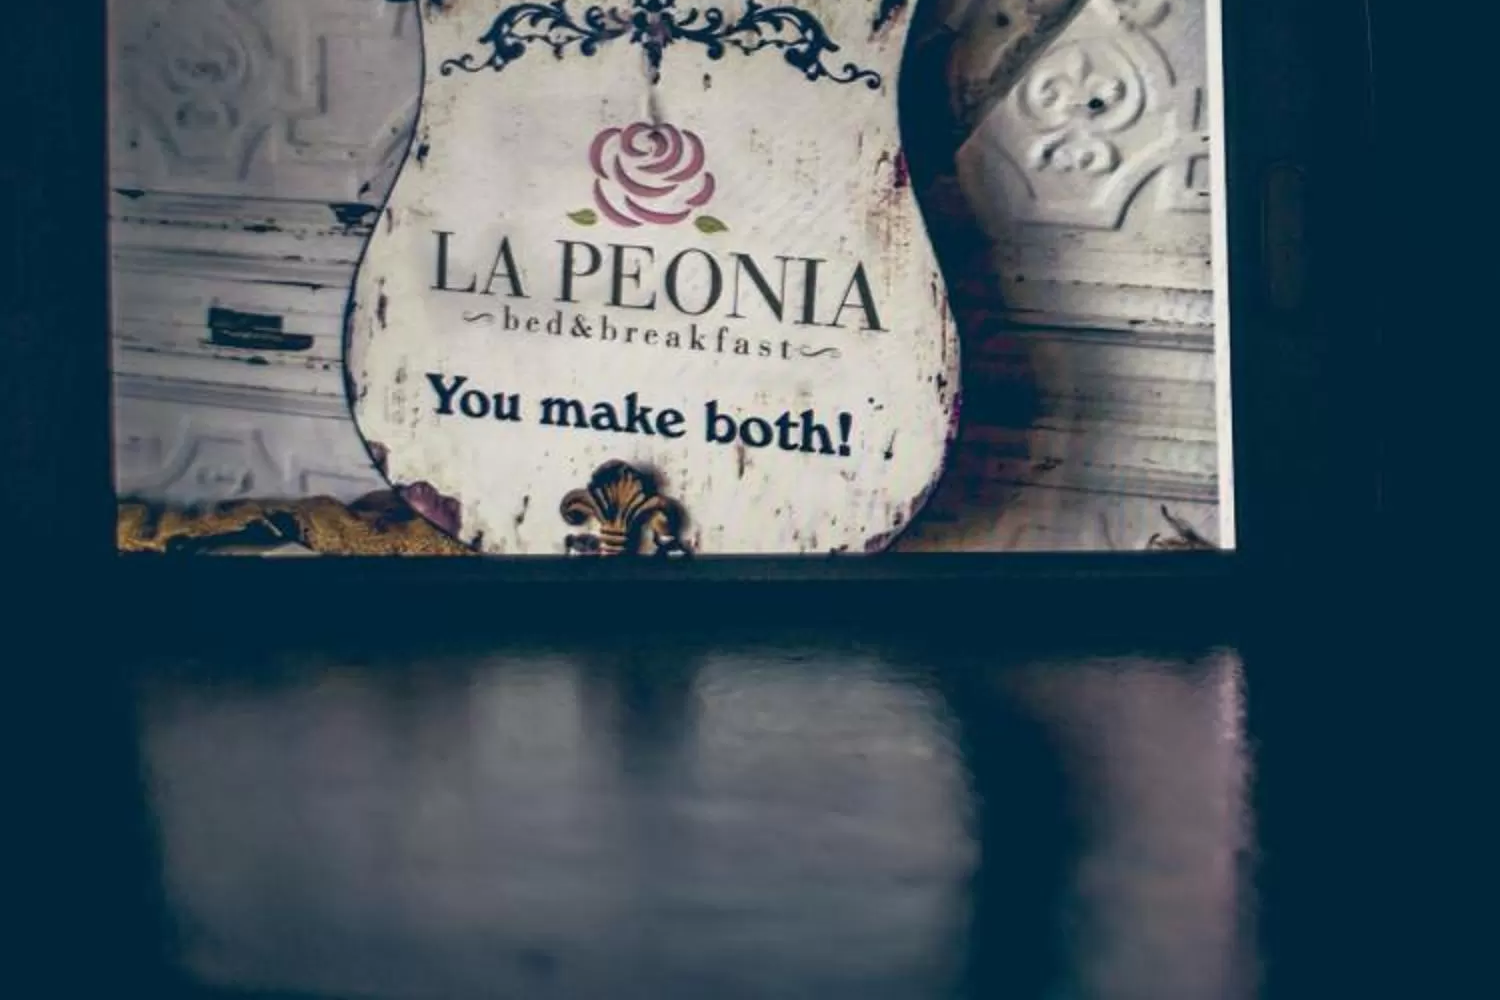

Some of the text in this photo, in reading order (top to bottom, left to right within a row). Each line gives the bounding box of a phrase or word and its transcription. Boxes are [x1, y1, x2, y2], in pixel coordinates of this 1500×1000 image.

[431, 230, 889, 332] LA PEONIA
[426, 372, 853, 457] You make both!
